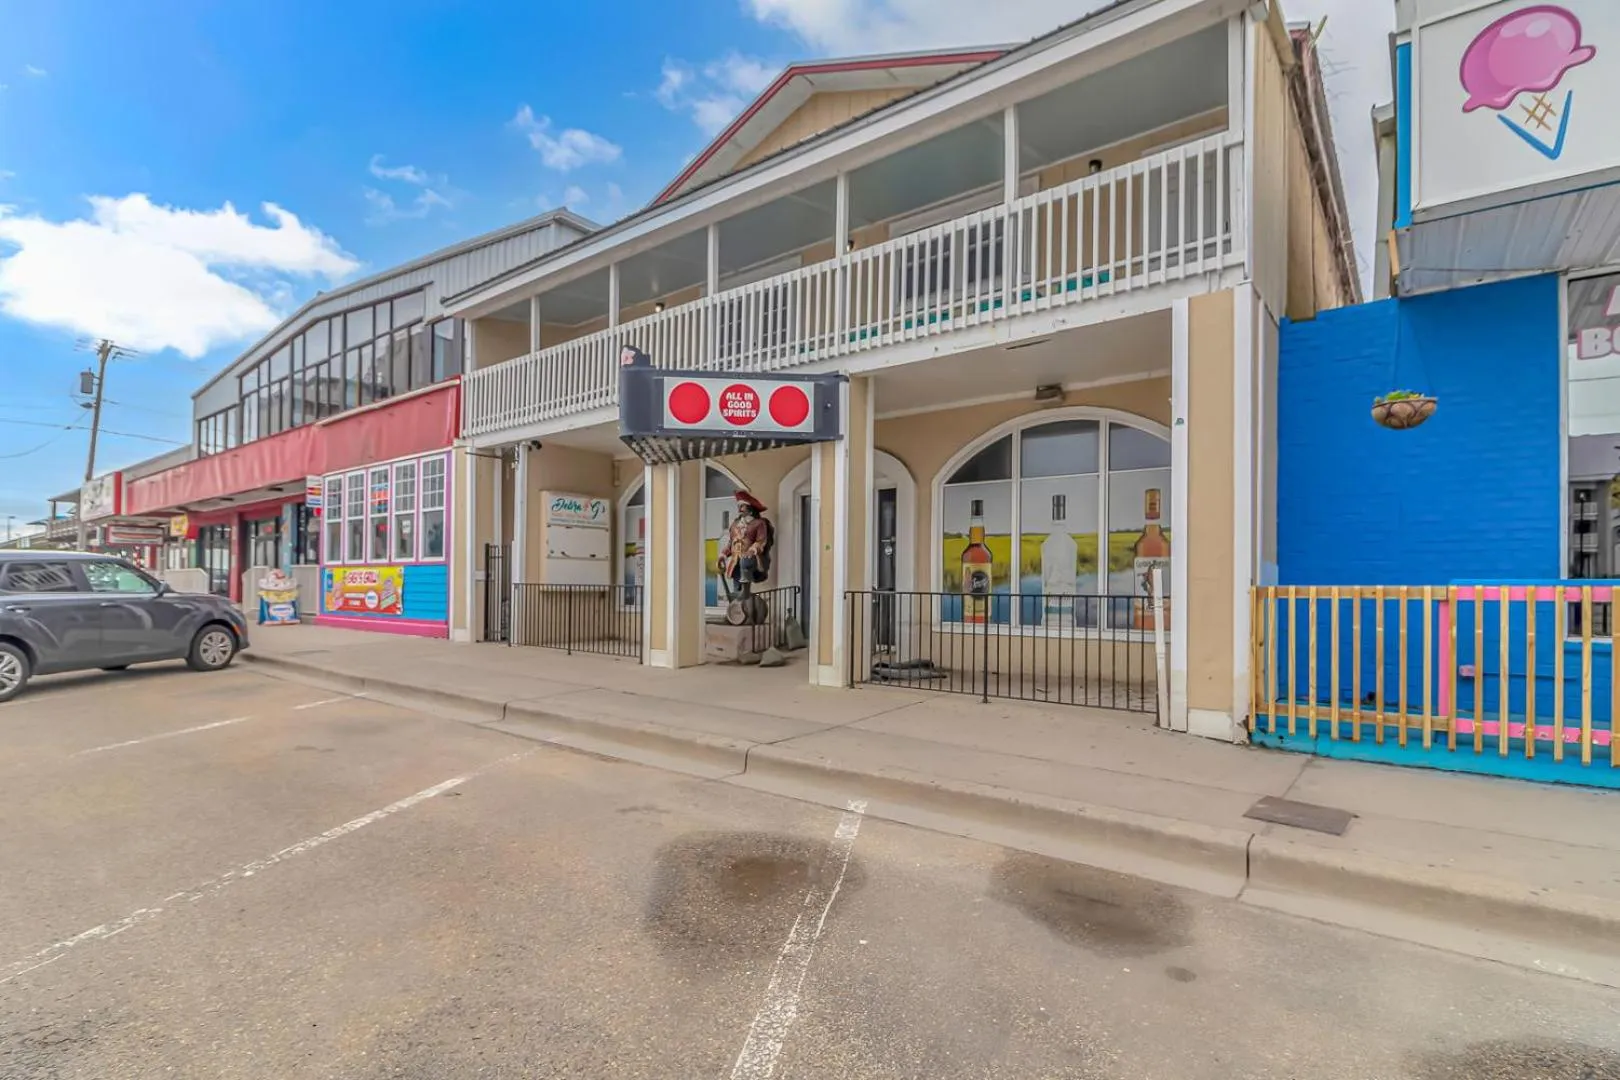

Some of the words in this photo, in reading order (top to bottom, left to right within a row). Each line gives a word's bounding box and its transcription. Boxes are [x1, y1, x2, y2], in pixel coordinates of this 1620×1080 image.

[725, 392, 742, 401] ALL
[744, 392, 754, 401] IN
[727, 401, 752, 409] GOOD
[723, 409, 757, 418] SPIRITS
